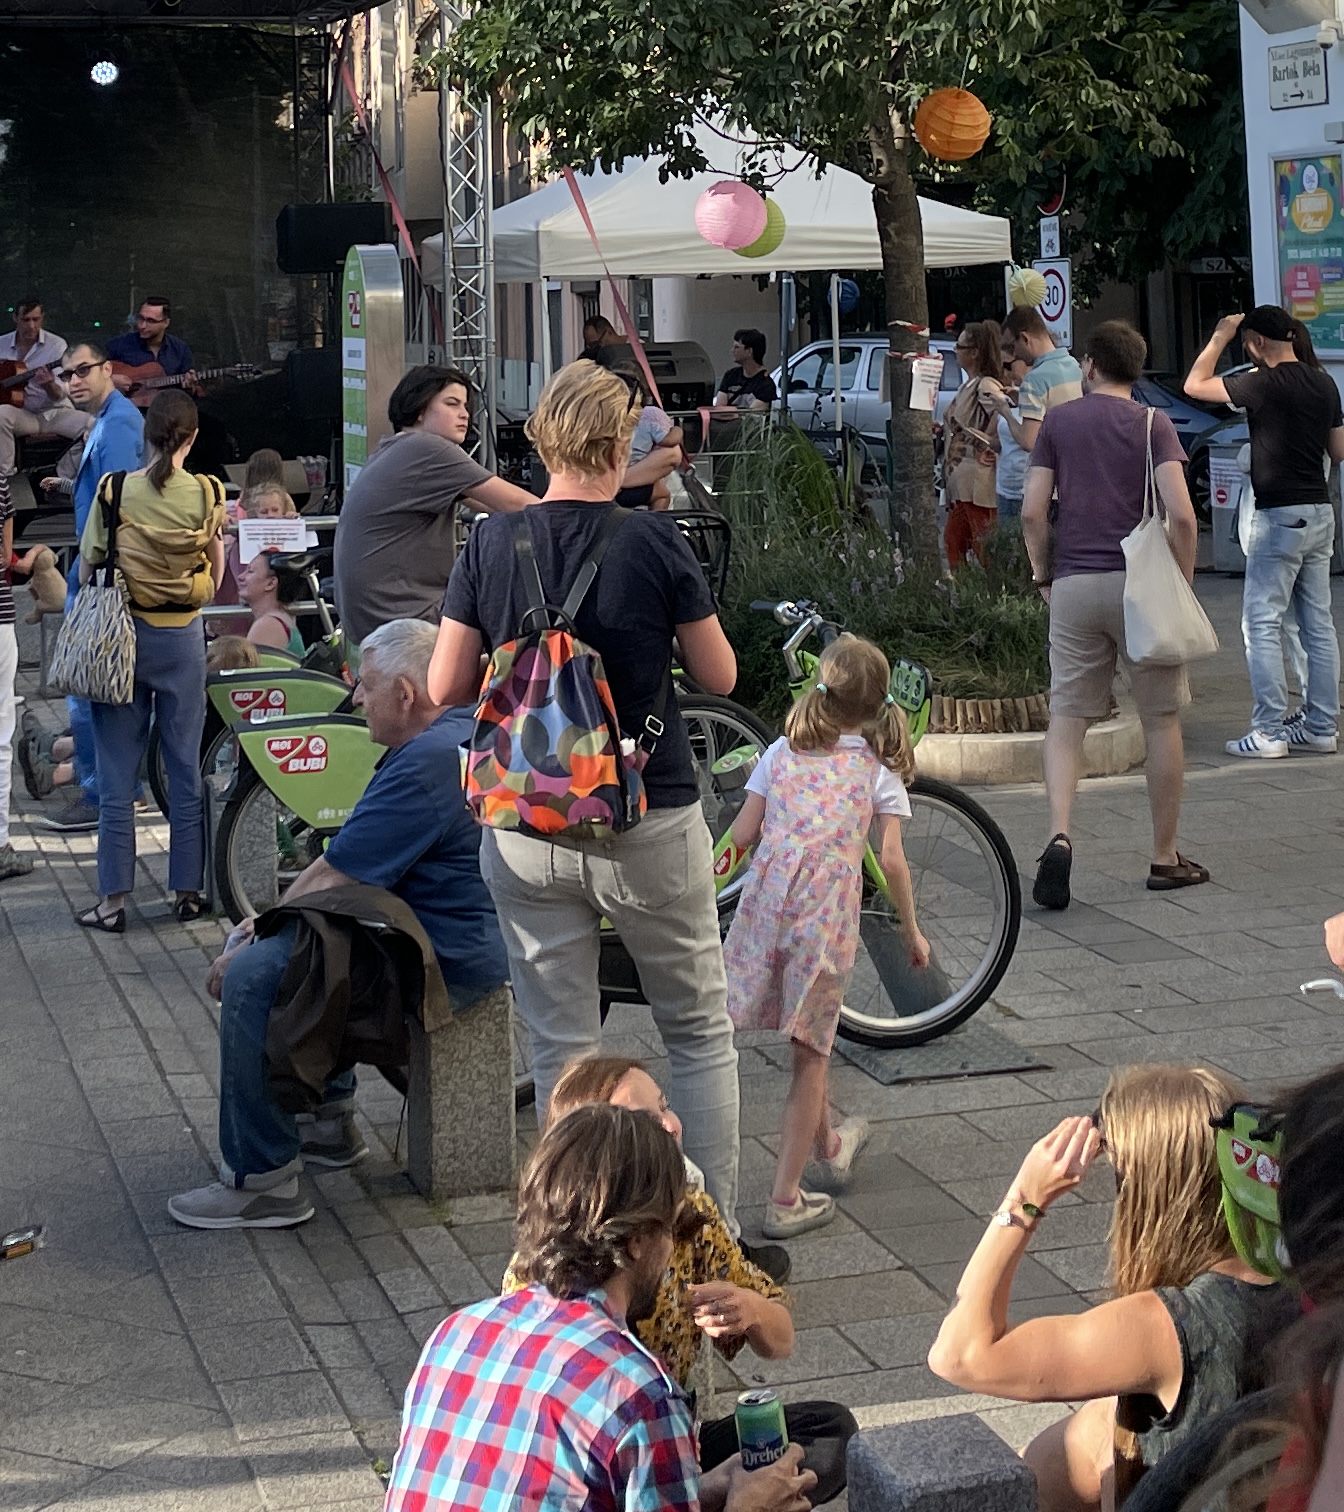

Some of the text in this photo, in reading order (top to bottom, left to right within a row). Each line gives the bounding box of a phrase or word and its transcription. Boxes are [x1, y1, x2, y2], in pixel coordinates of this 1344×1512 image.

[1272, 59, 1321, 82] Bartók Béla
[1044, 286, 1059, 306] 30
[234, 692, 254, 702] MOL
[250, 708, 285, 720] BUBI
[270, 740, 292, 752] MOL
[288, 757, 327, 772] BUBI
[743, 1446, 784, 1466] Dreher
